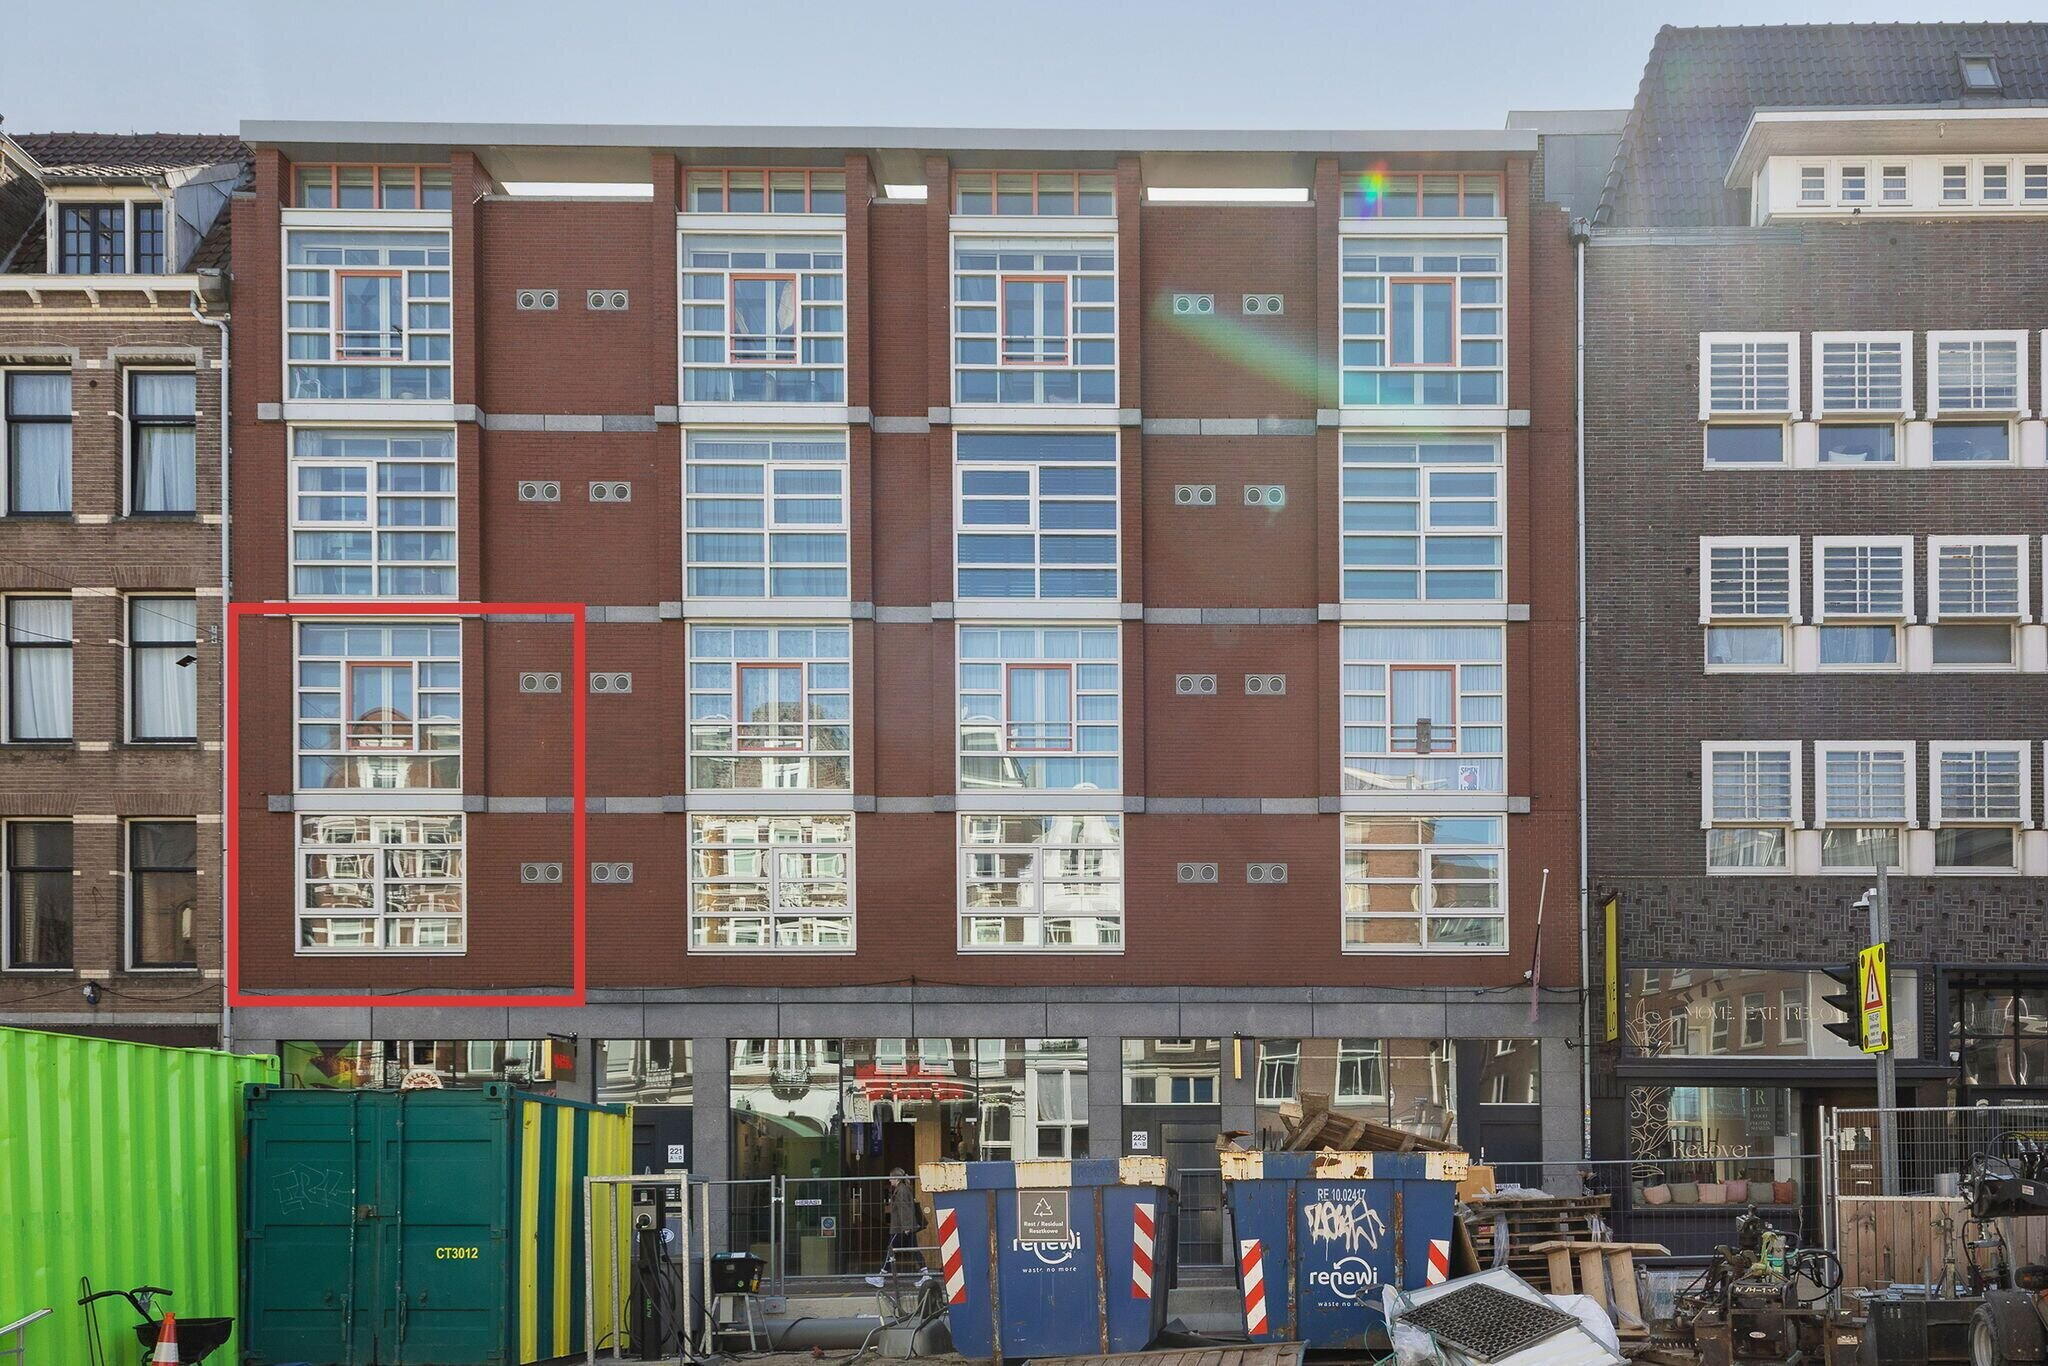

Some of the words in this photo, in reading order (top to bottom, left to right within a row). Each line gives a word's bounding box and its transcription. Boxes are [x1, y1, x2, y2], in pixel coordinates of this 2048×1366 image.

[1684, 1006, 1736, 1020] MOVE.
[1743, 1007, 1778, 1020] EAT.
[1786, 1007, 1844, 1021] RECOV
[1672, 1140, 1752, 1159] Recover
[1332, 1188, 1367, 1201] 10.02417
[436, 1247, 479, 1259] CT3012
